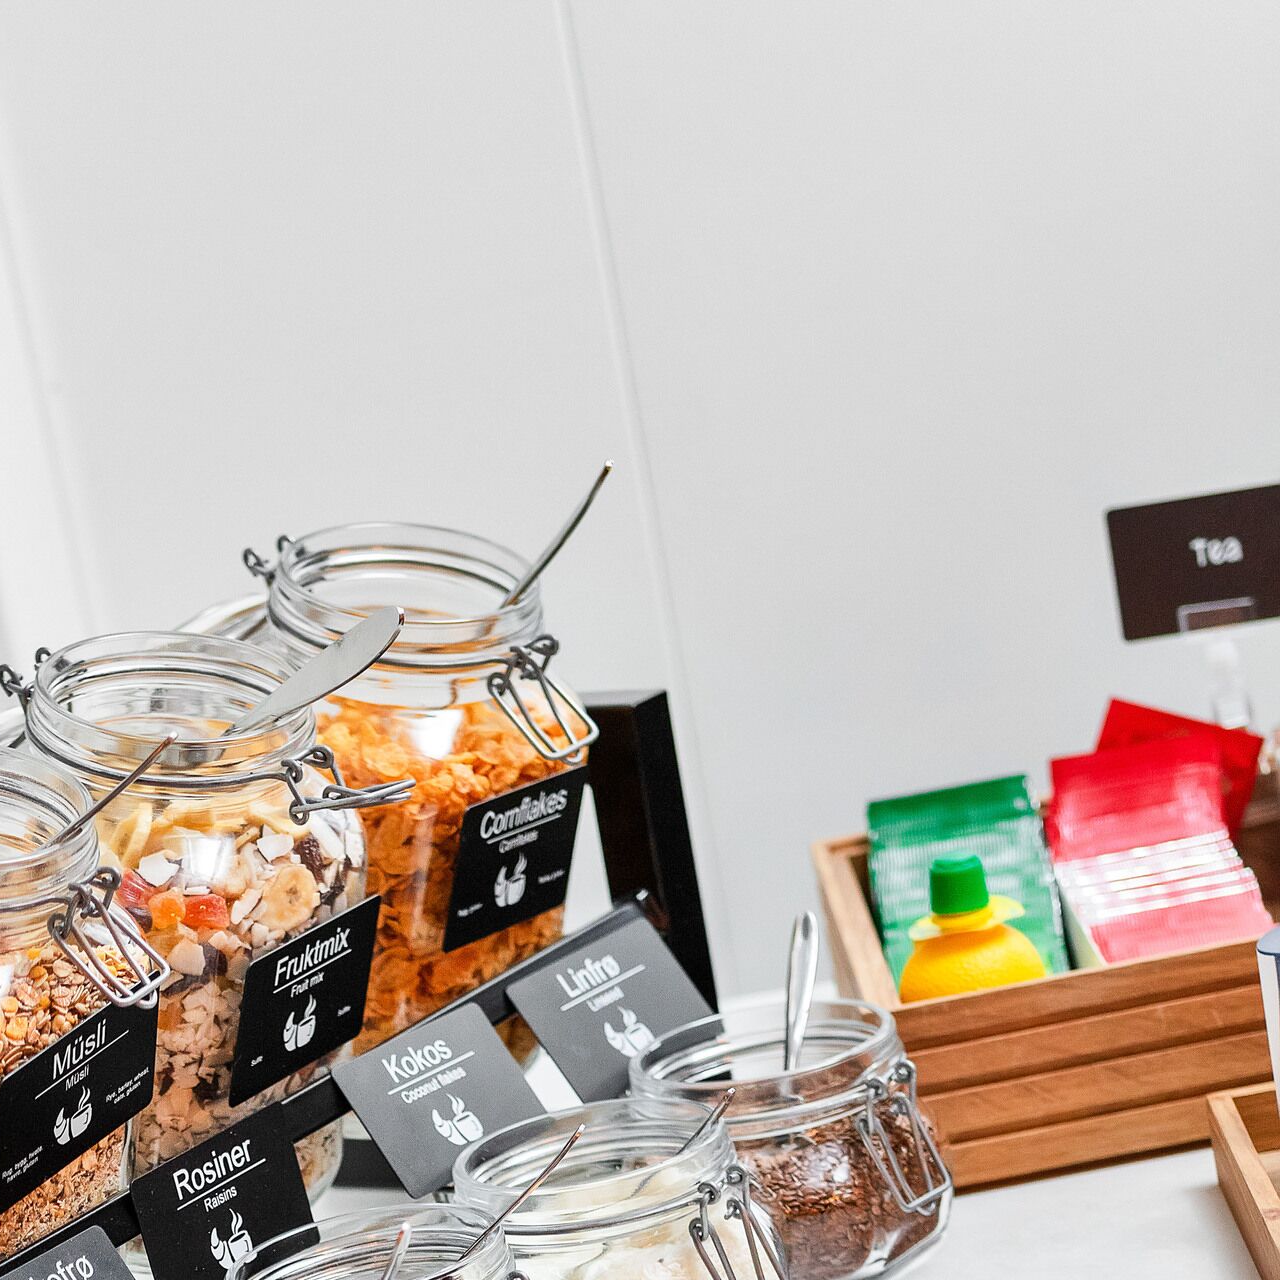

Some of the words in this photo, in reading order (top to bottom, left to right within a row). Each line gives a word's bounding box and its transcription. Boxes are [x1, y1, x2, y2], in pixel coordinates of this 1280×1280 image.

[1189, 536, 1244, 568] Tea
[273, 927, 351, 987] Fruktmix
[309, 971, 325, 990] mix
[52, 1019, 107, 1080] Müsli
[381, 1039, 453, 1083] Kokos
[65, 1065, 90, 1091] Müsli
[401, 1078, 441, 1104] Coconut
[172, 1139, 251, 1201] Rosiner
[203, 1185, 238, 1212] Raisins
